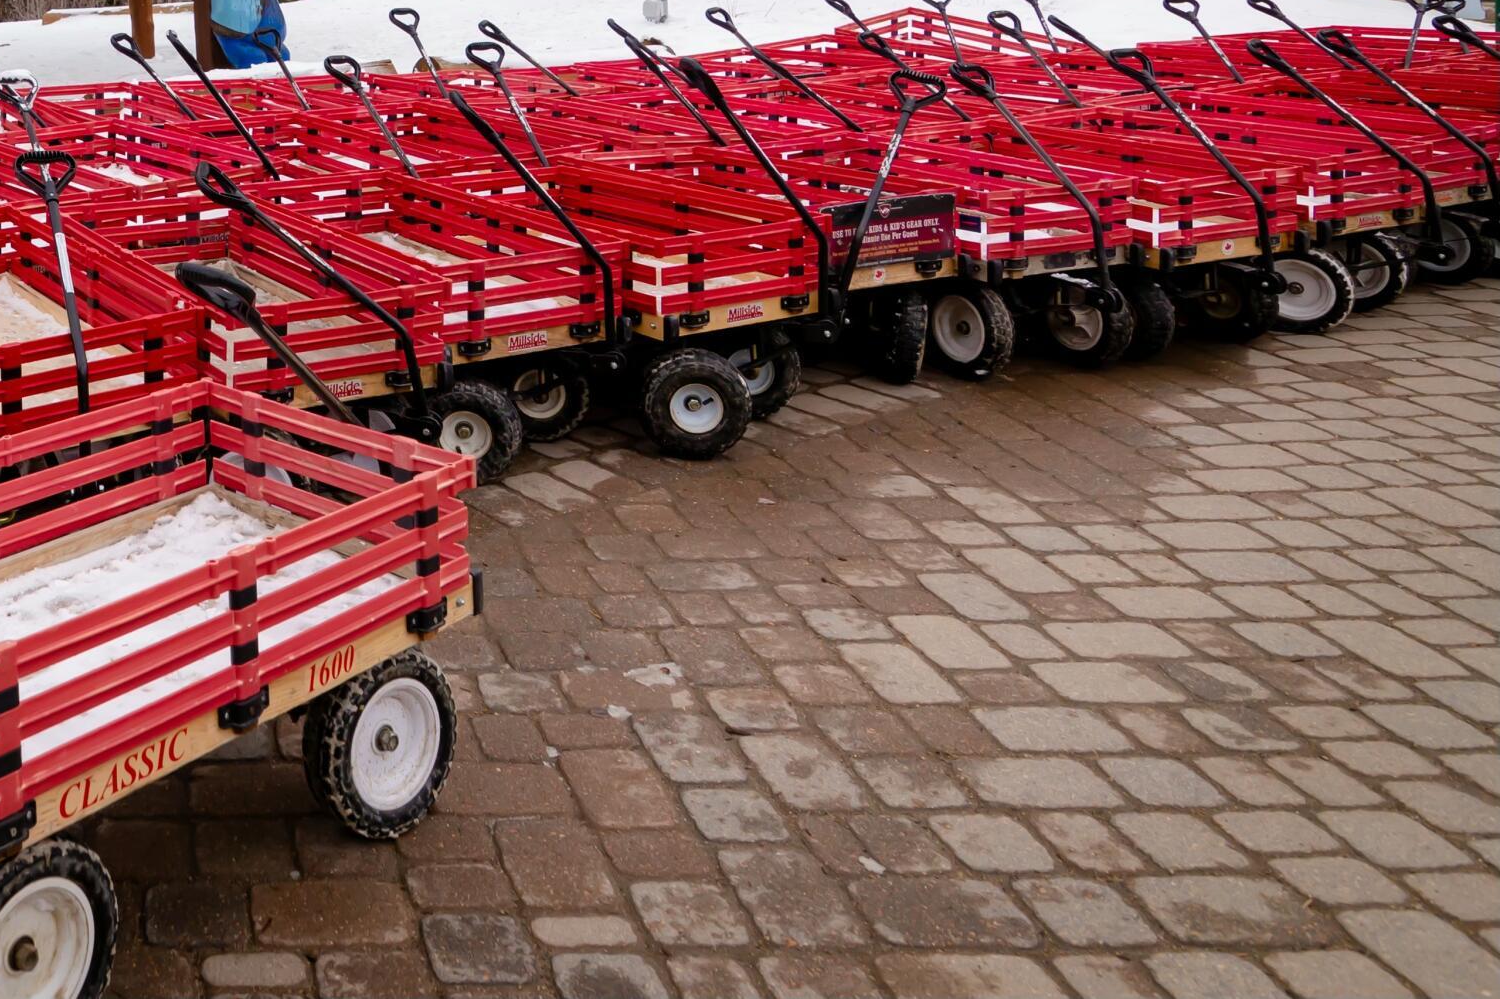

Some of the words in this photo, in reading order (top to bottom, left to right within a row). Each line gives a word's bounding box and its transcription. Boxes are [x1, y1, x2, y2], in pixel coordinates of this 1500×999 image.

[832, 231, 844, 239] USE
[845, 229, 852, 237] TO
[869, 225, 882, 233] KIDS
[890, 222, 905, 230] KID'S
[906, 220, 923, 228] GEAR
[881, 233, 891, 241] Use
[892, 231, 901, 239] Per
[903, 230, 918, 238] Guest
[729, 305, 761, 318] Millside
[510, 332, 545, 346] Millside
[309, 645, 355, 693] 1600
[59, 727, 187, 818] CLASSIC
